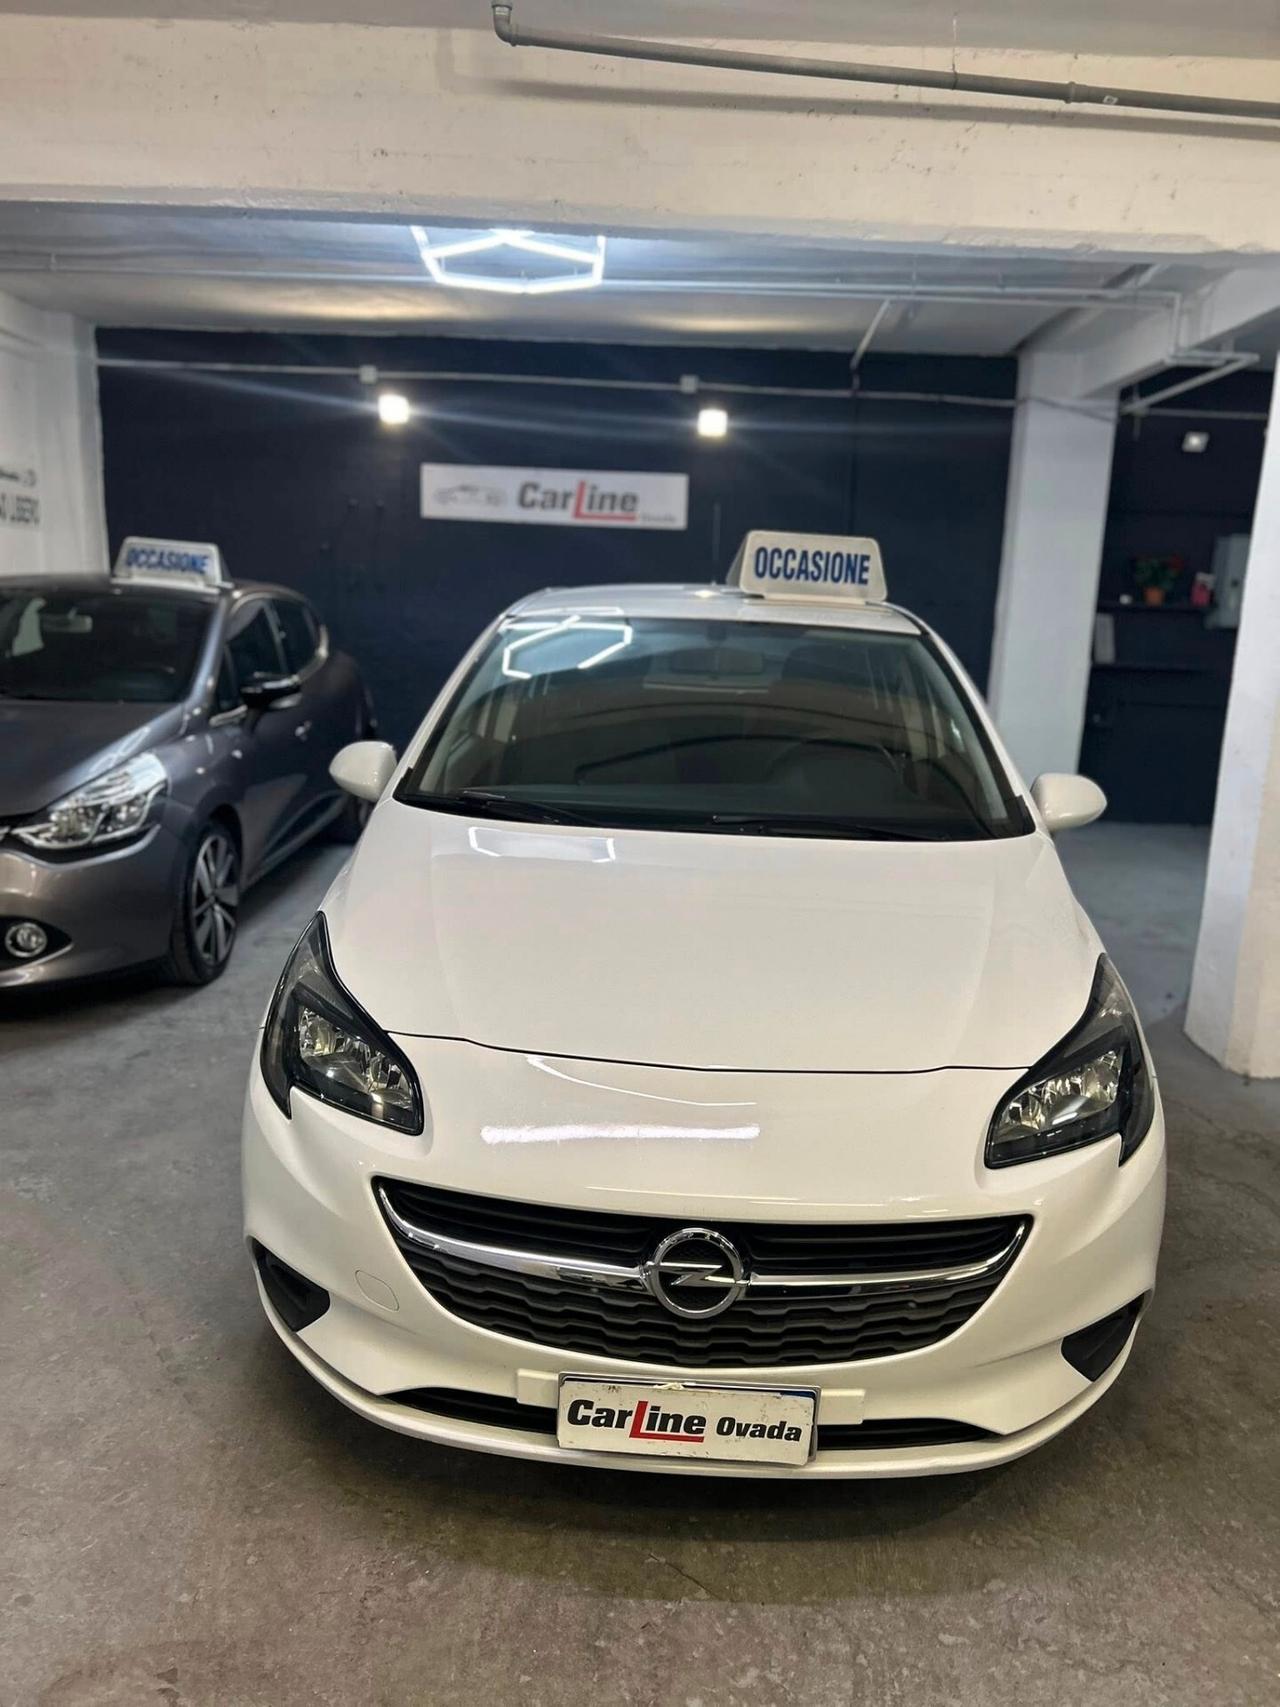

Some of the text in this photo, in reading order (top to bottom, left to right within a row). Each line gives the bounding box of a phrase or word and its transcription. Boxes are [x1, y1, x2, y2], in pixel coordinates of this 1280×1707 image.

[517, 480, 639, 522] CarLine
[126, 548, 209, 575] OCCASIONE
[754, 547, 871, 585] OCCASIONE
[567, 1400, 802, 1443] CarLine Ovada
